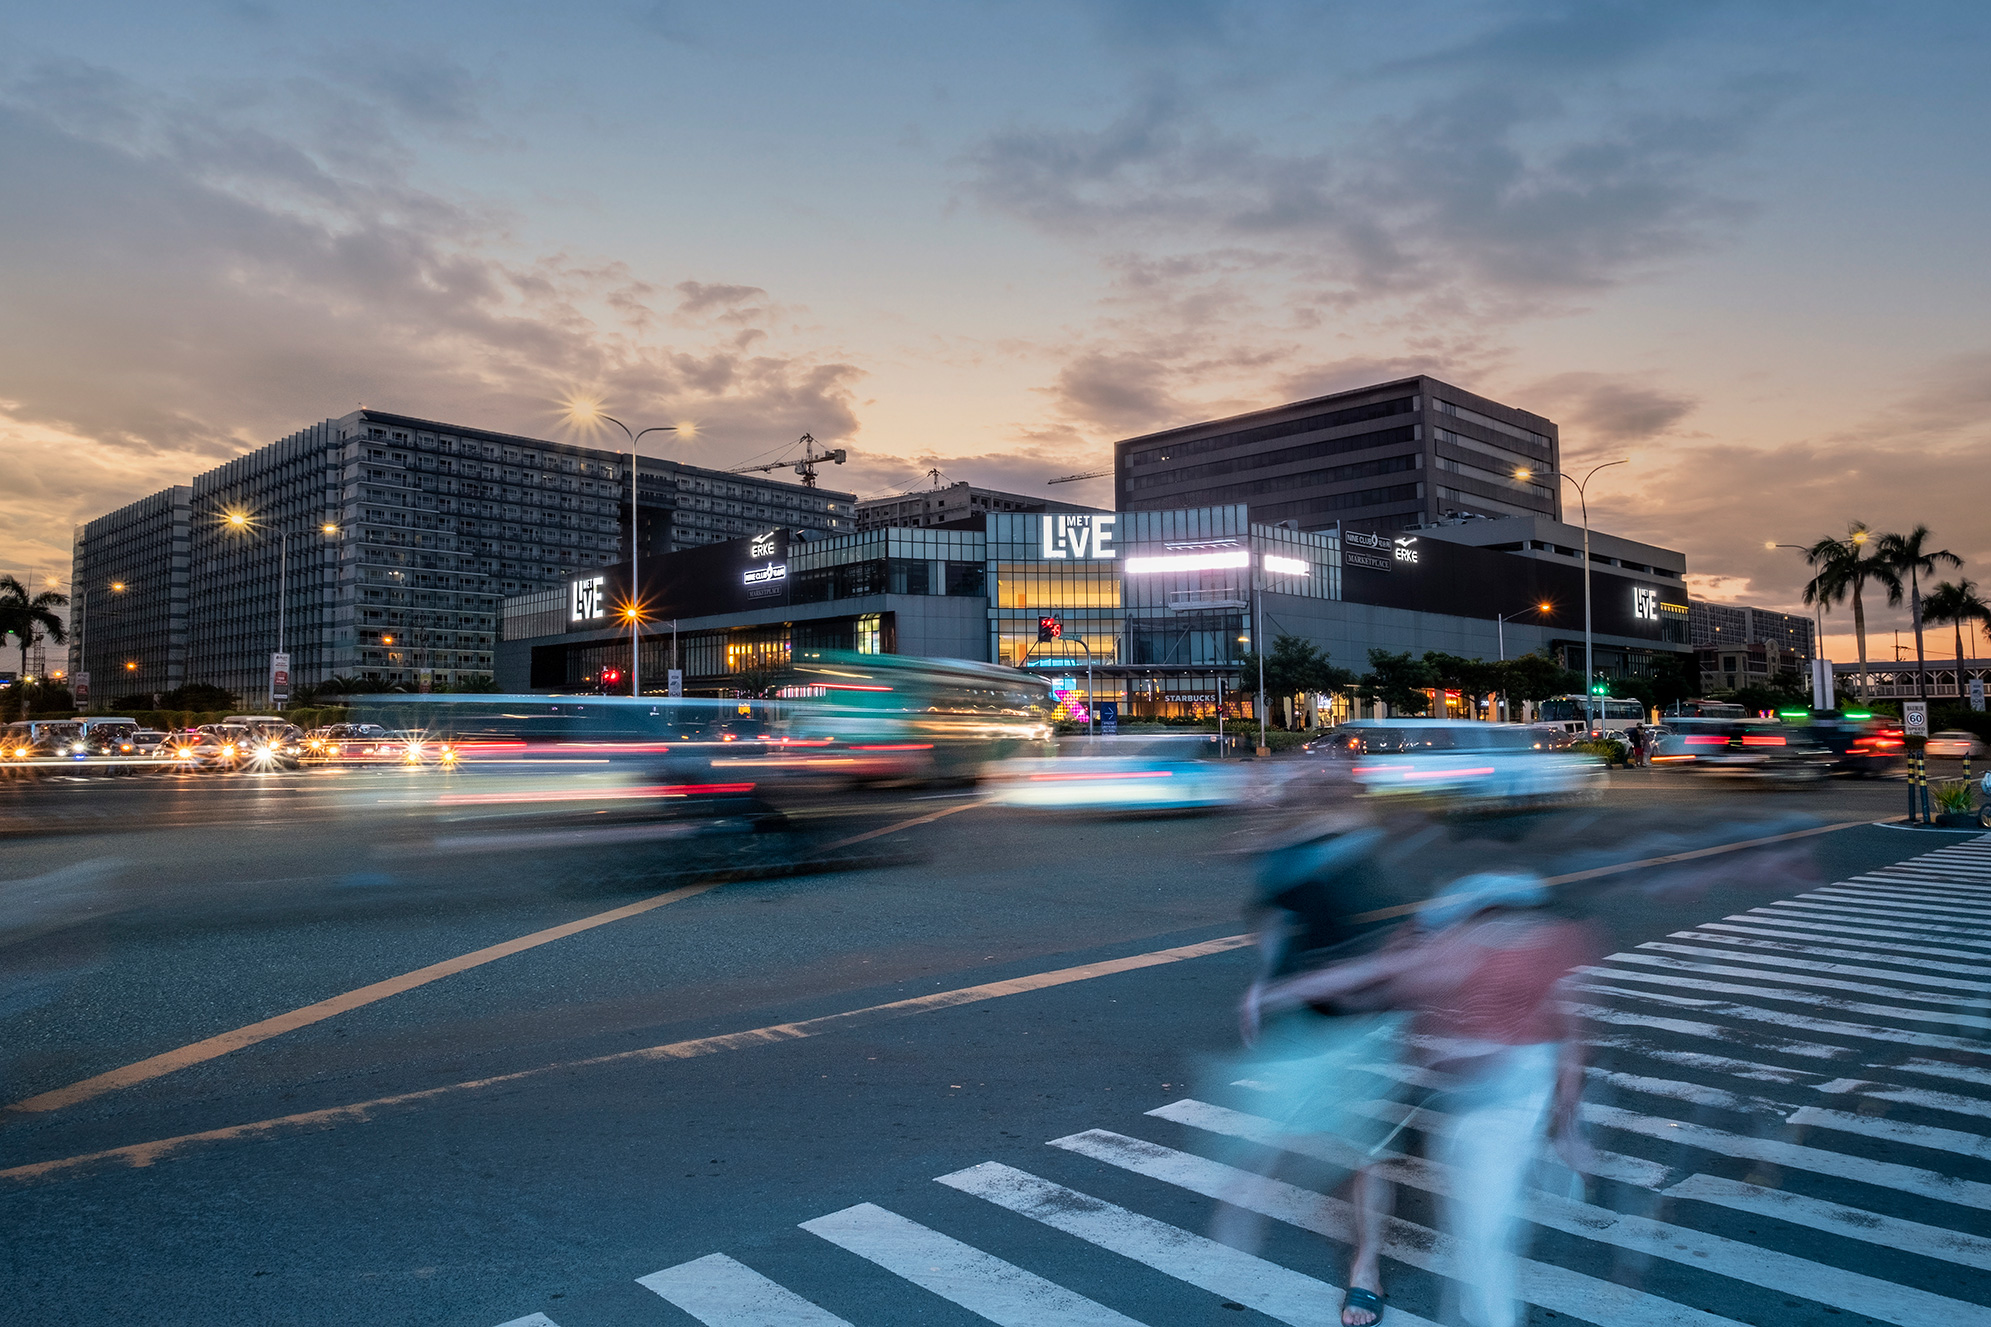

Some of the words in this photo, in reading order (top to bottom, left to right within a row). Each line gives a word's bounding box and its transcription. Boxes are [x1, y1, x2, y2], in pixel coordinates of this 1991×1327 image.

[1066, 515, 1090, 527] MET
[1347, 534, 1359, 543] NINE
[1359, 536, 1372, 545] CLUB
[752, 542, 775, 558] ERKE
[1395, 547, 1418, 563] ERKE
[1348, 554, 1390, 569] MARKETPLACE
[1909, 714, 1922, 722] 60
